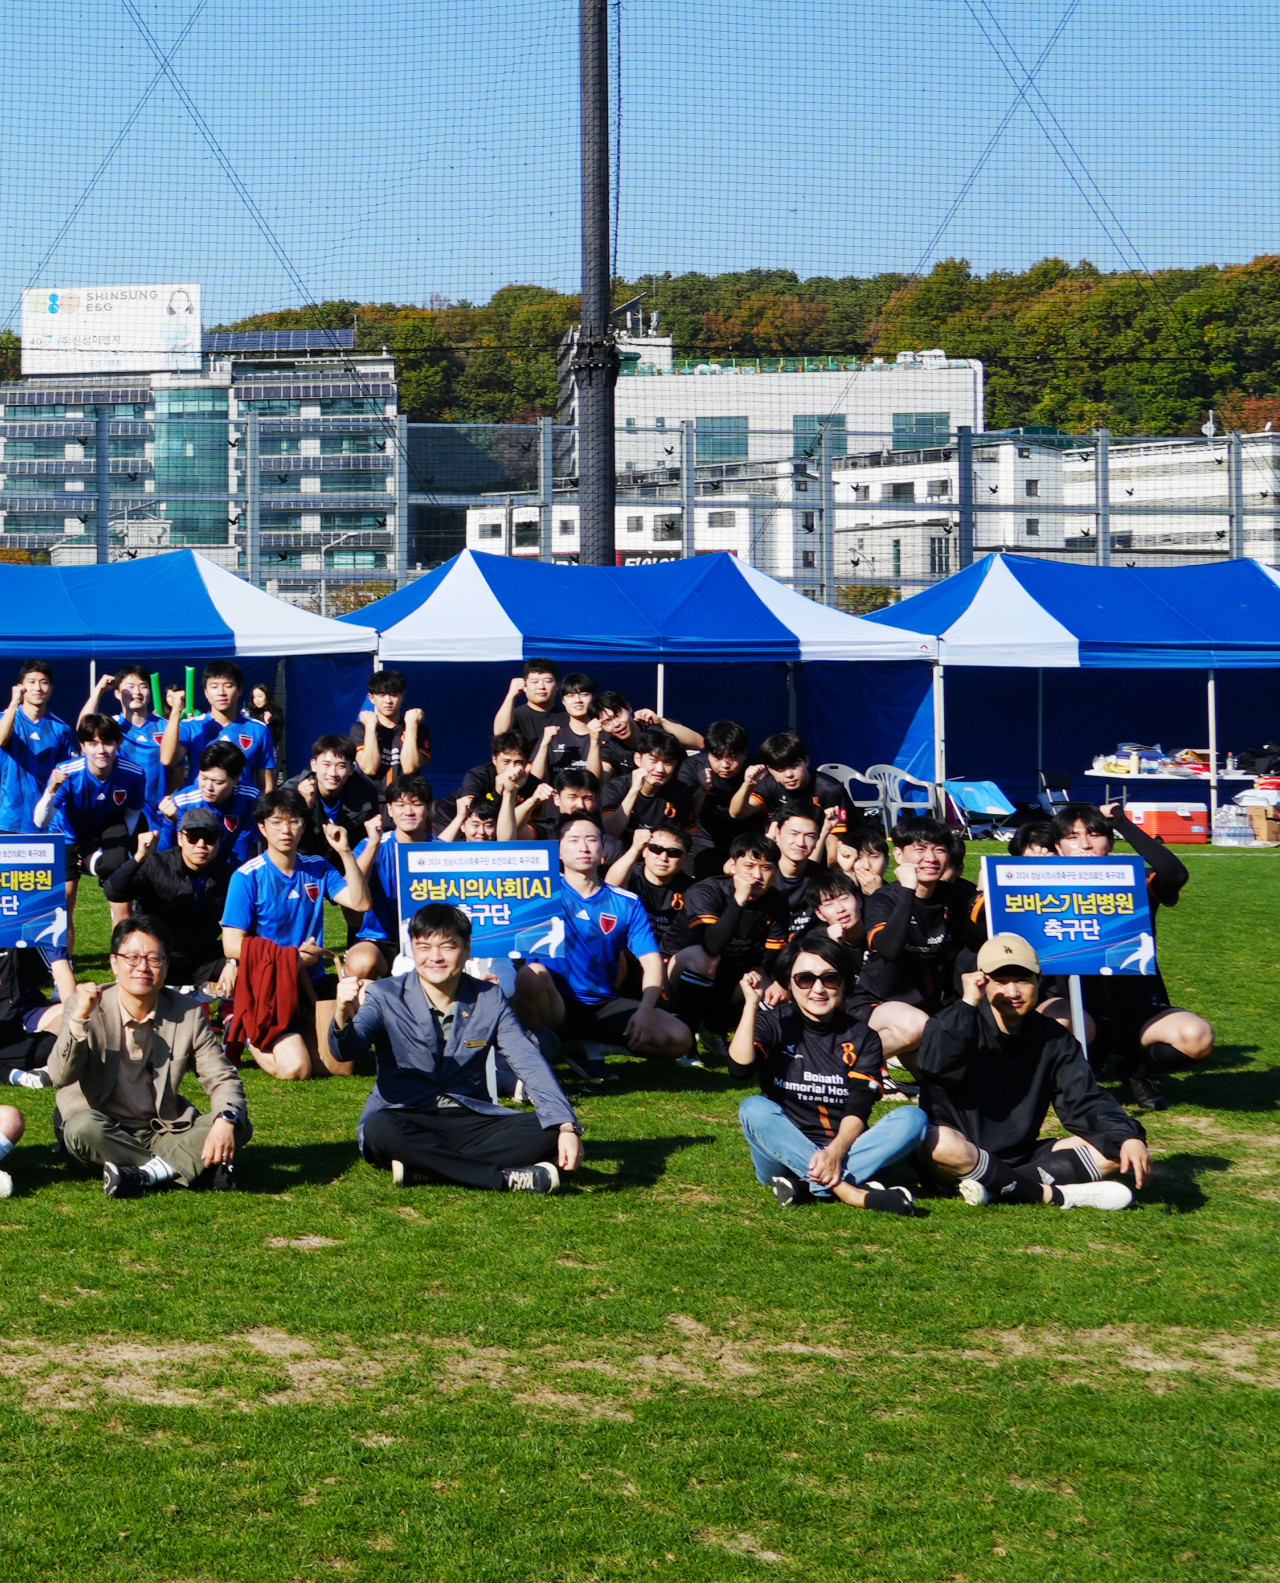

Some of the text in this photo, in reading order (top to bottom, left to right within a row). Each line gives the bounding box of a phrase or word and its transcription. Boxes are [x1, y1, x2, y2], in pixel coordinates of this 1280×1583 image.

[86, 290, 159, 301] SHINSUNG
[86, 302, 113, 312] E&G
[409, 876, 551, 901] 성남시의사회[A]
[1004, 892, 1135, 915] 보바스기념병원
[1043, 918, 1101, 941] 축구단
[773, 1076, 849, 1097] Memorial Hos
[803, 1071, 844, 1085] Bobath
[796, 1093, 849, 1104] TeamGeis
